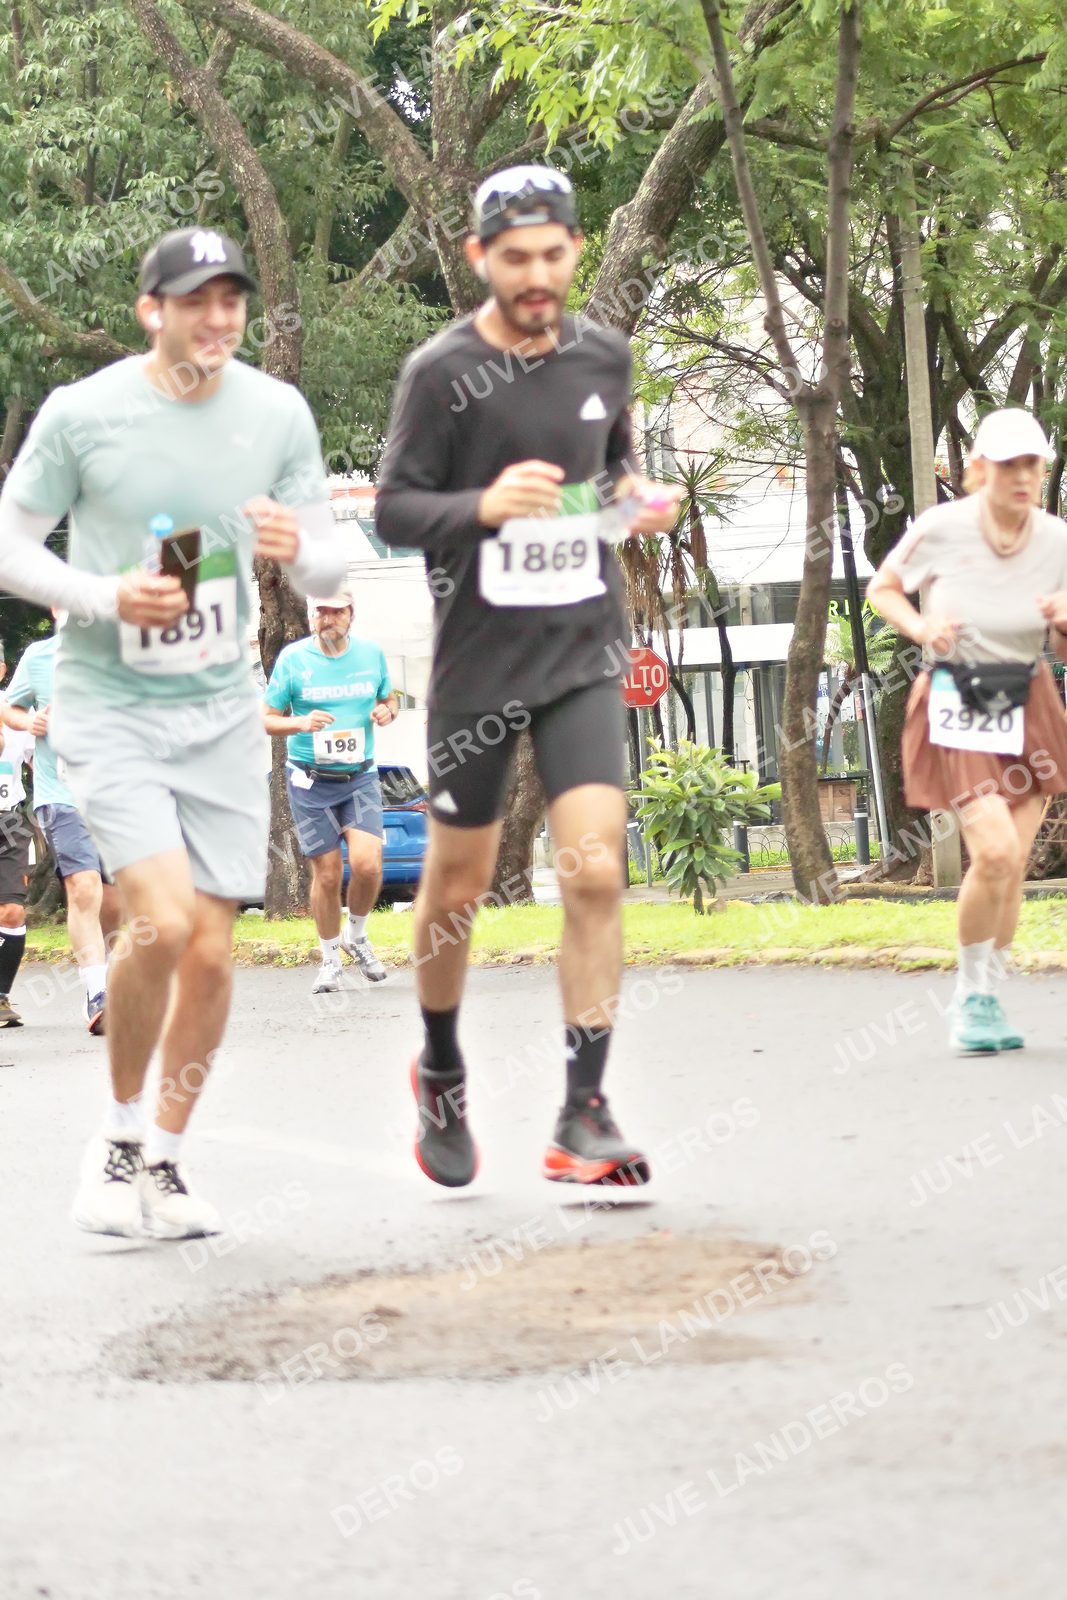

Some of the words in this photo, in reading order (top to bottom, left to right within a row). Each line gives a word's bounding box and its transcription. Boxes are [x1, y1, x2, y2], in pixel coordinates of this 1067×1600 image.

[498, 540, 587, 572] 1869
[140, 603, 222, 649] 1891
[302, 681, 375, 700] PERDURA
[939, 708, 1013, 733] 2920
[324, 738, 357, 754] 198
